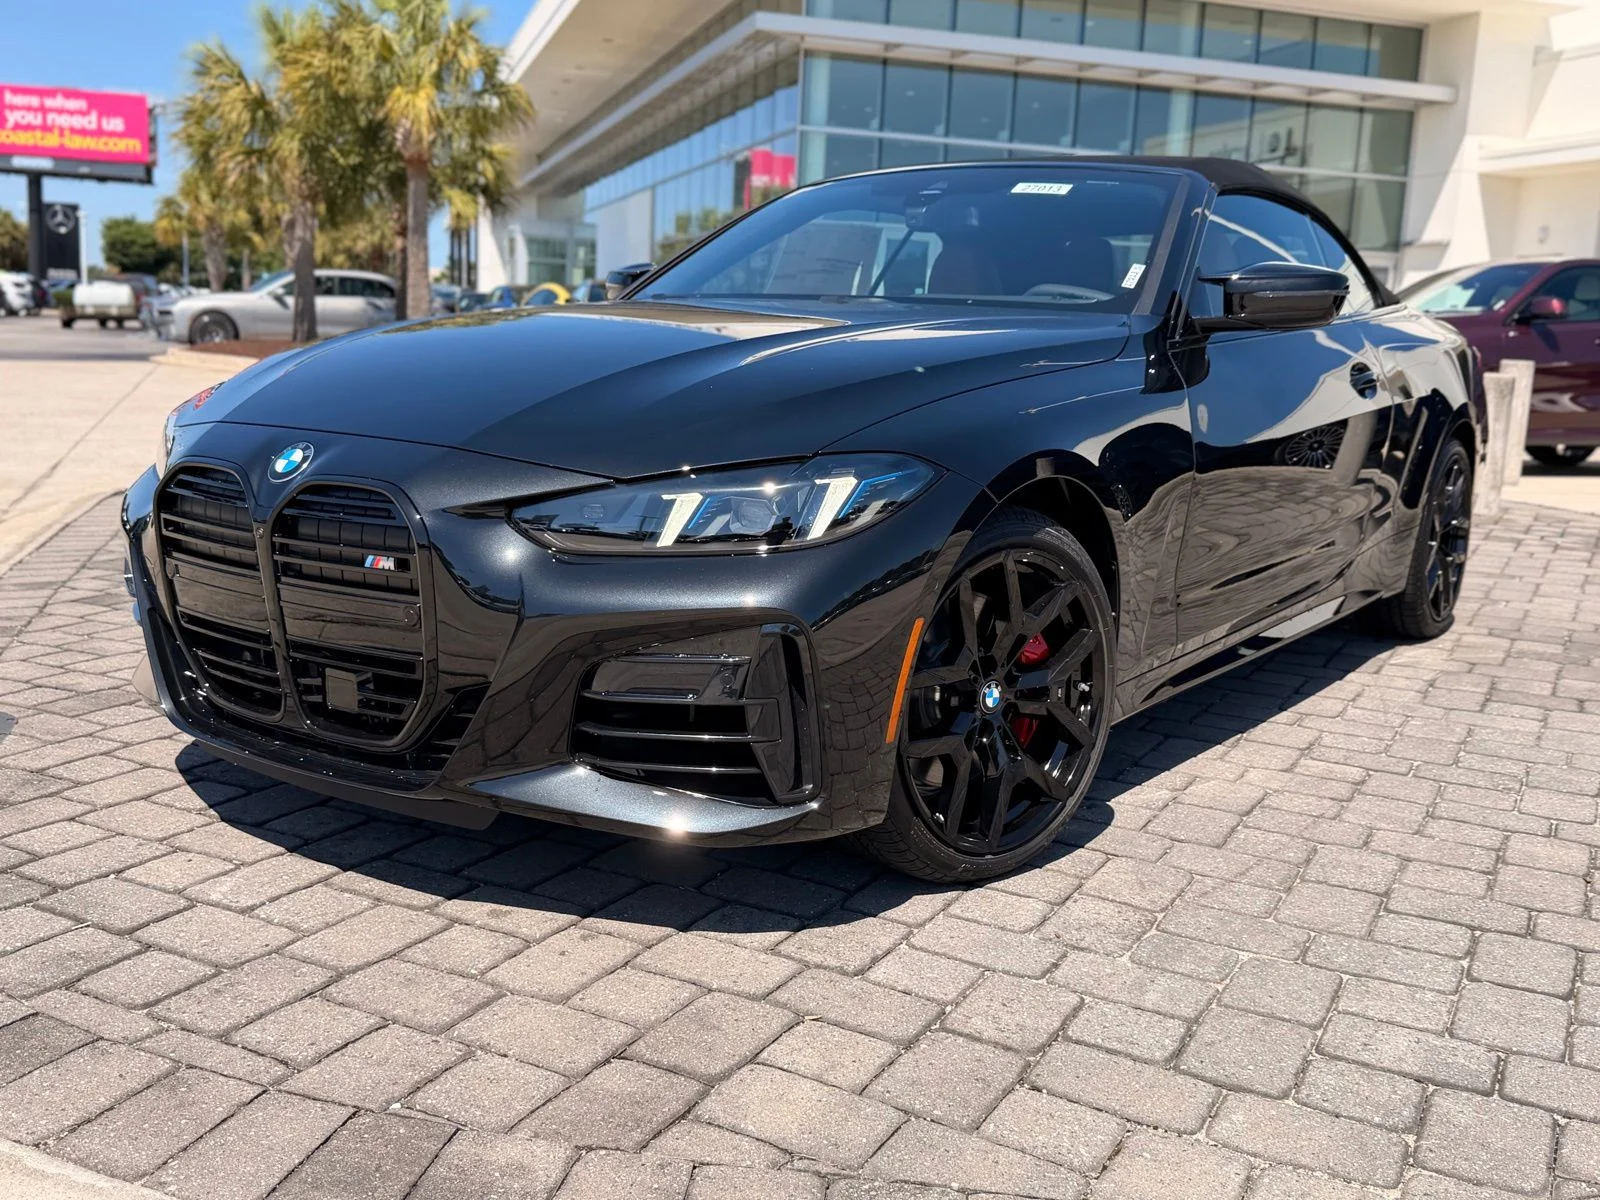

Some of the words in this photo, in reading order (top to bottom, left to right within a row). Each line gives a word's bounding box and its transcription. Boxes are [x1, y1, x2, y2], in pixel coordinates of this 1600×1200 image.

[3, 89, 40, 108] here
[43, 93, 88, 111] when
[4, 109, 43, 128] you
[46, 110, 98, 131] need
[101, 116, 126, 132] us
[0, 127, 142, 153] oastal-law.com
